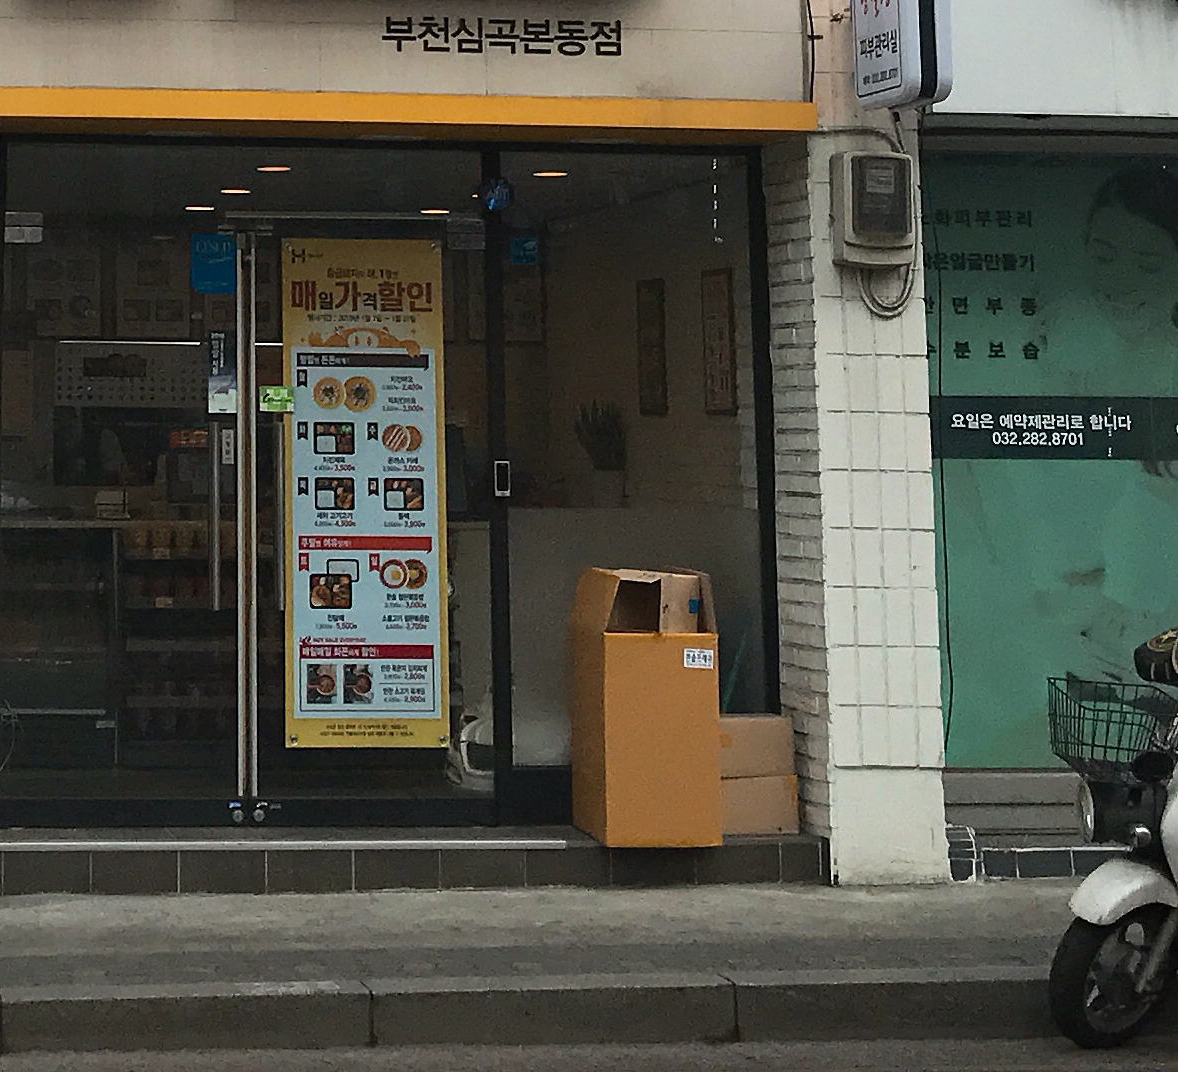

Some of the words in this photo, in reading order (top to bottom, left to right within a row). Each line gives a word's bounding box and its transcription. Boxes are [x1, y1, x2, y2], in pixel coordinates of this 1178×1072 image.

[381, 15, 622, 57] 부천심곡본동점
[859, 28, 898, 61] 피부관리실
[290, 280, 433, 312] 매일가격할인
[950, 412, 995, 429] 요일은
[998, 412, 1085, 430] 예약제관리로
[1089, 413, 1132, 431] 합니다
[991, 431, 1085, 447] 032.282.8701
